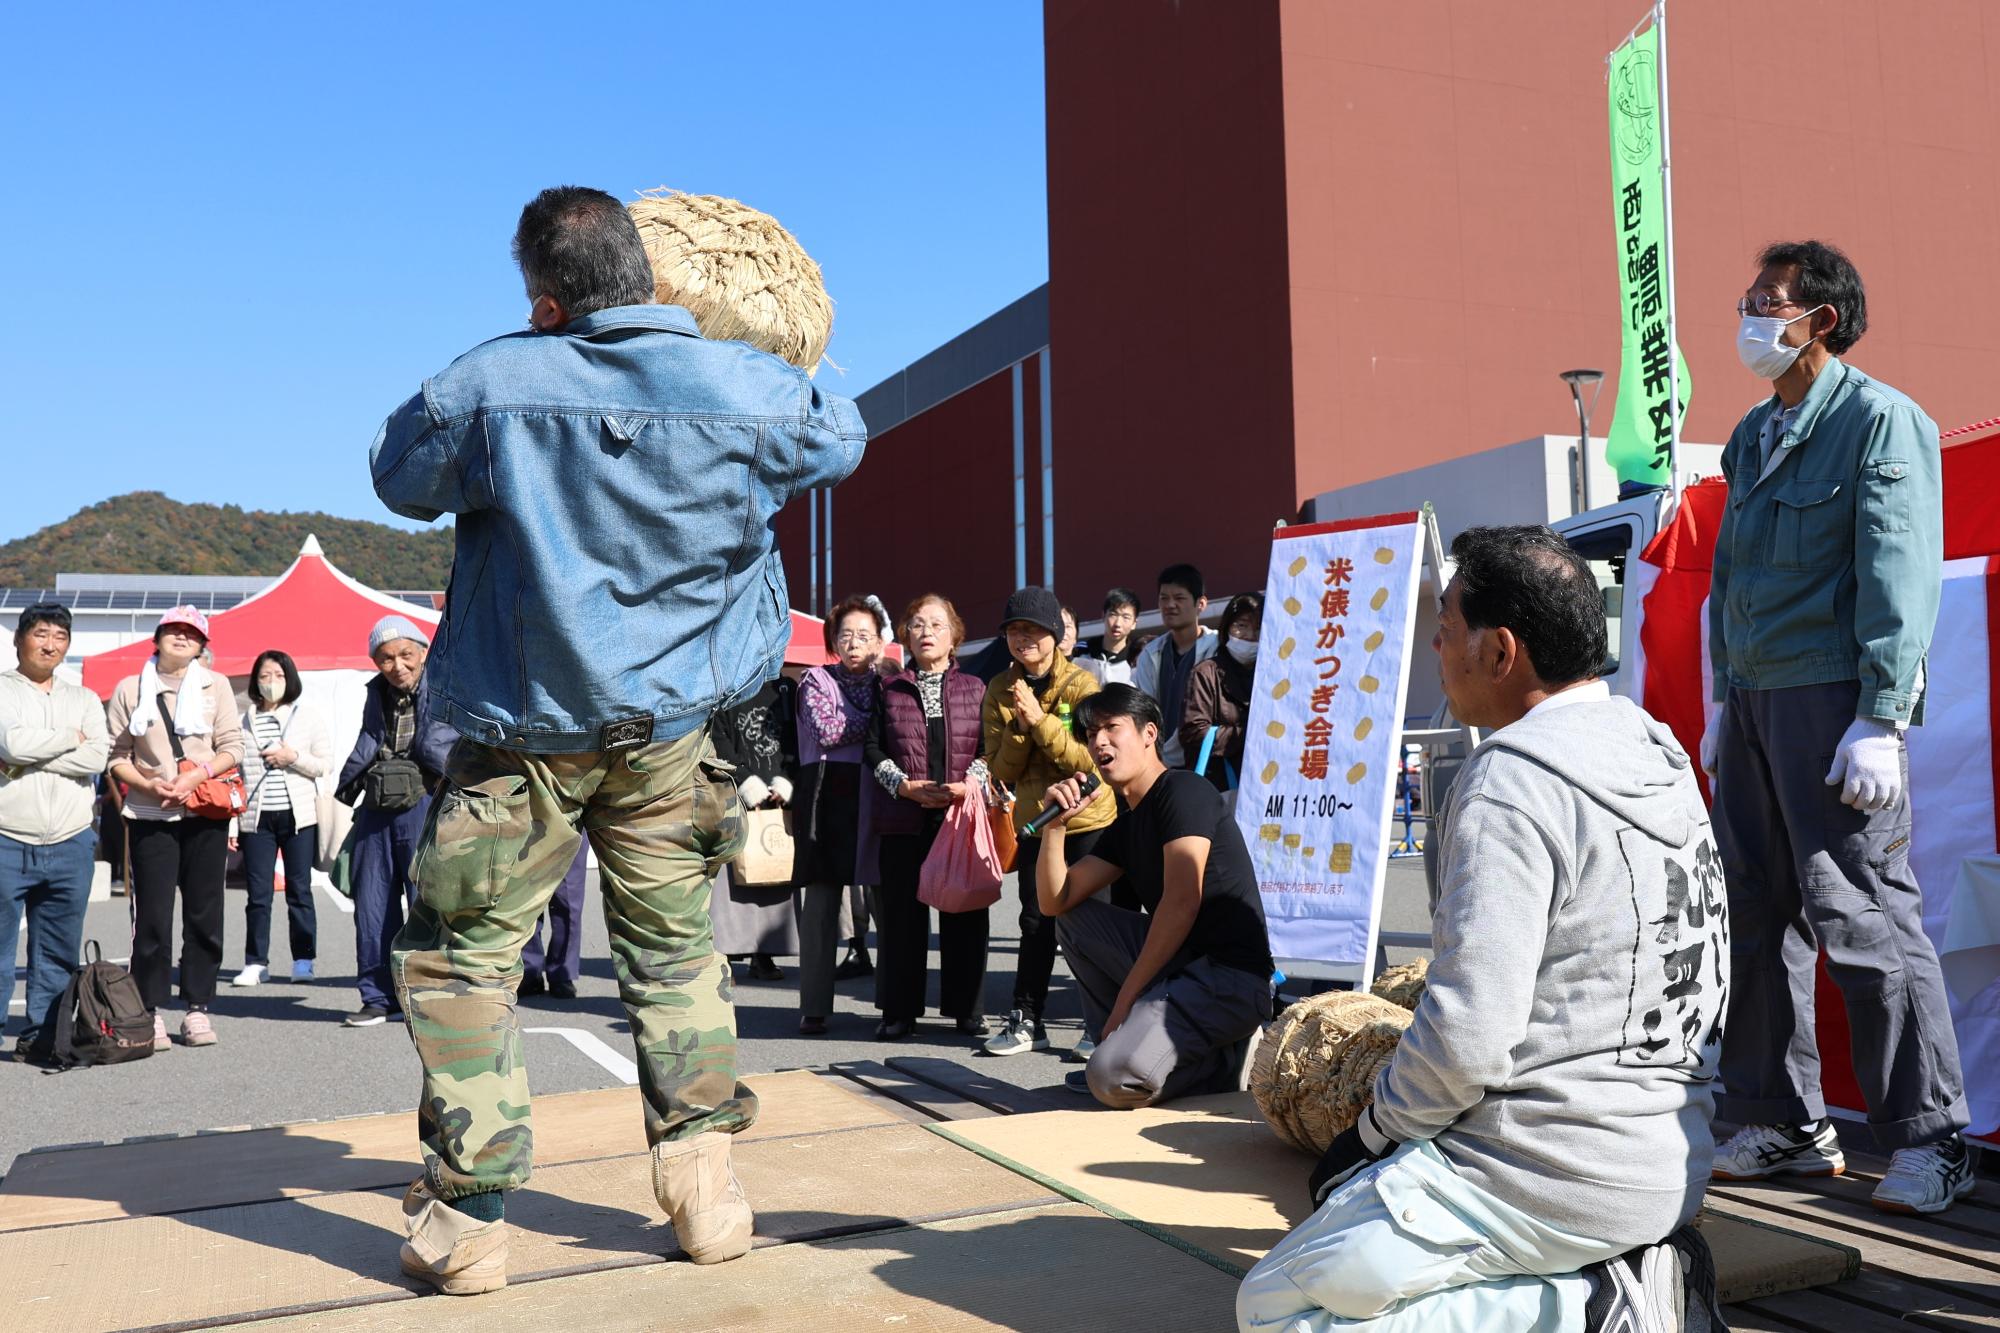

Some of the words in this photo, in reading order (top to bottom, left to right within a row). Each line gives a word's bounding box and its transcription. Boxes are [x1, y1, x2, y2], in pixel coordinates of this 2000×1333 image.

[1299, 557, 1354, 781] 米俵かつぎ会場
[1265, 795, 1284, 817] AM
